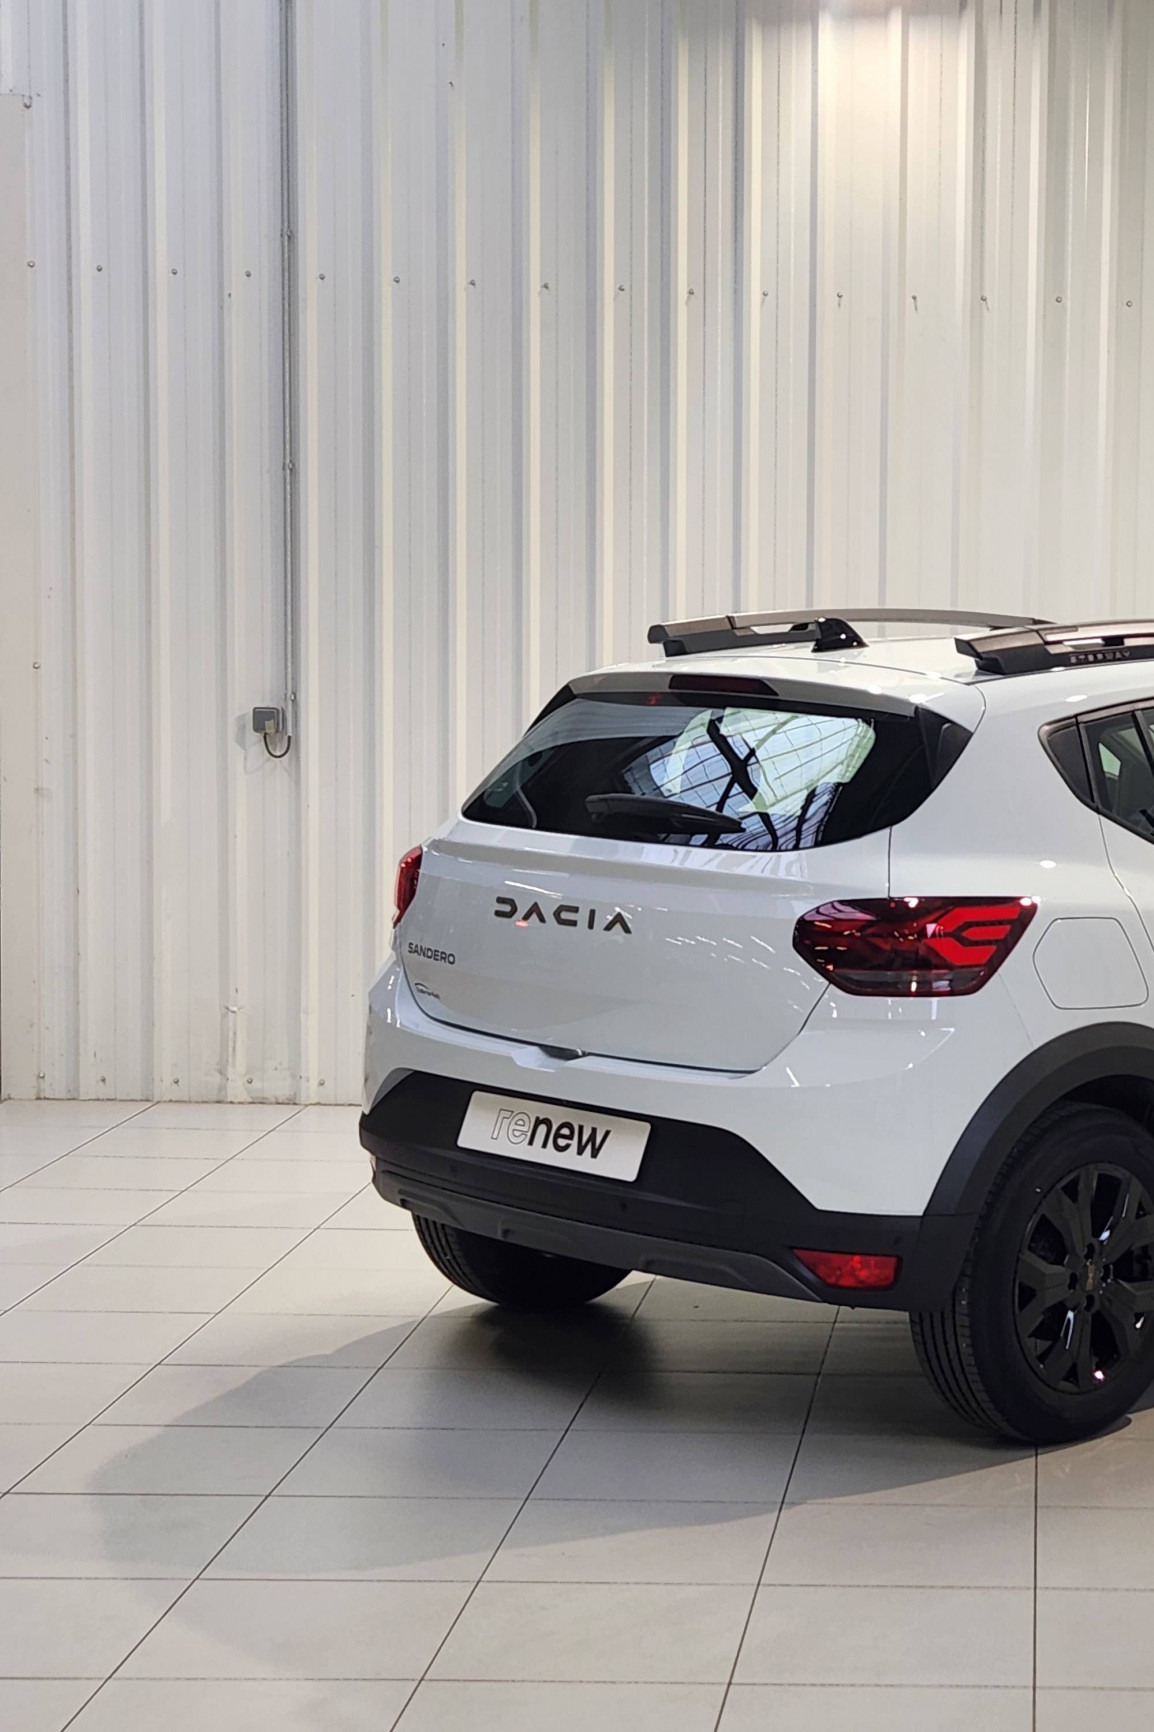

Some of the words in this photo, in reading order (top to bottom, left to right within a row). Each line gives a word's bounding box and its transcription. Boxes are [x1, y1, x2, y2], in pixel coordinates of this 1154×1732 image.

[494, 896, 632, 935] DACIA
[407, 941, 456, 965] SANDERO
[490, 1108, 612, 1160] renew
